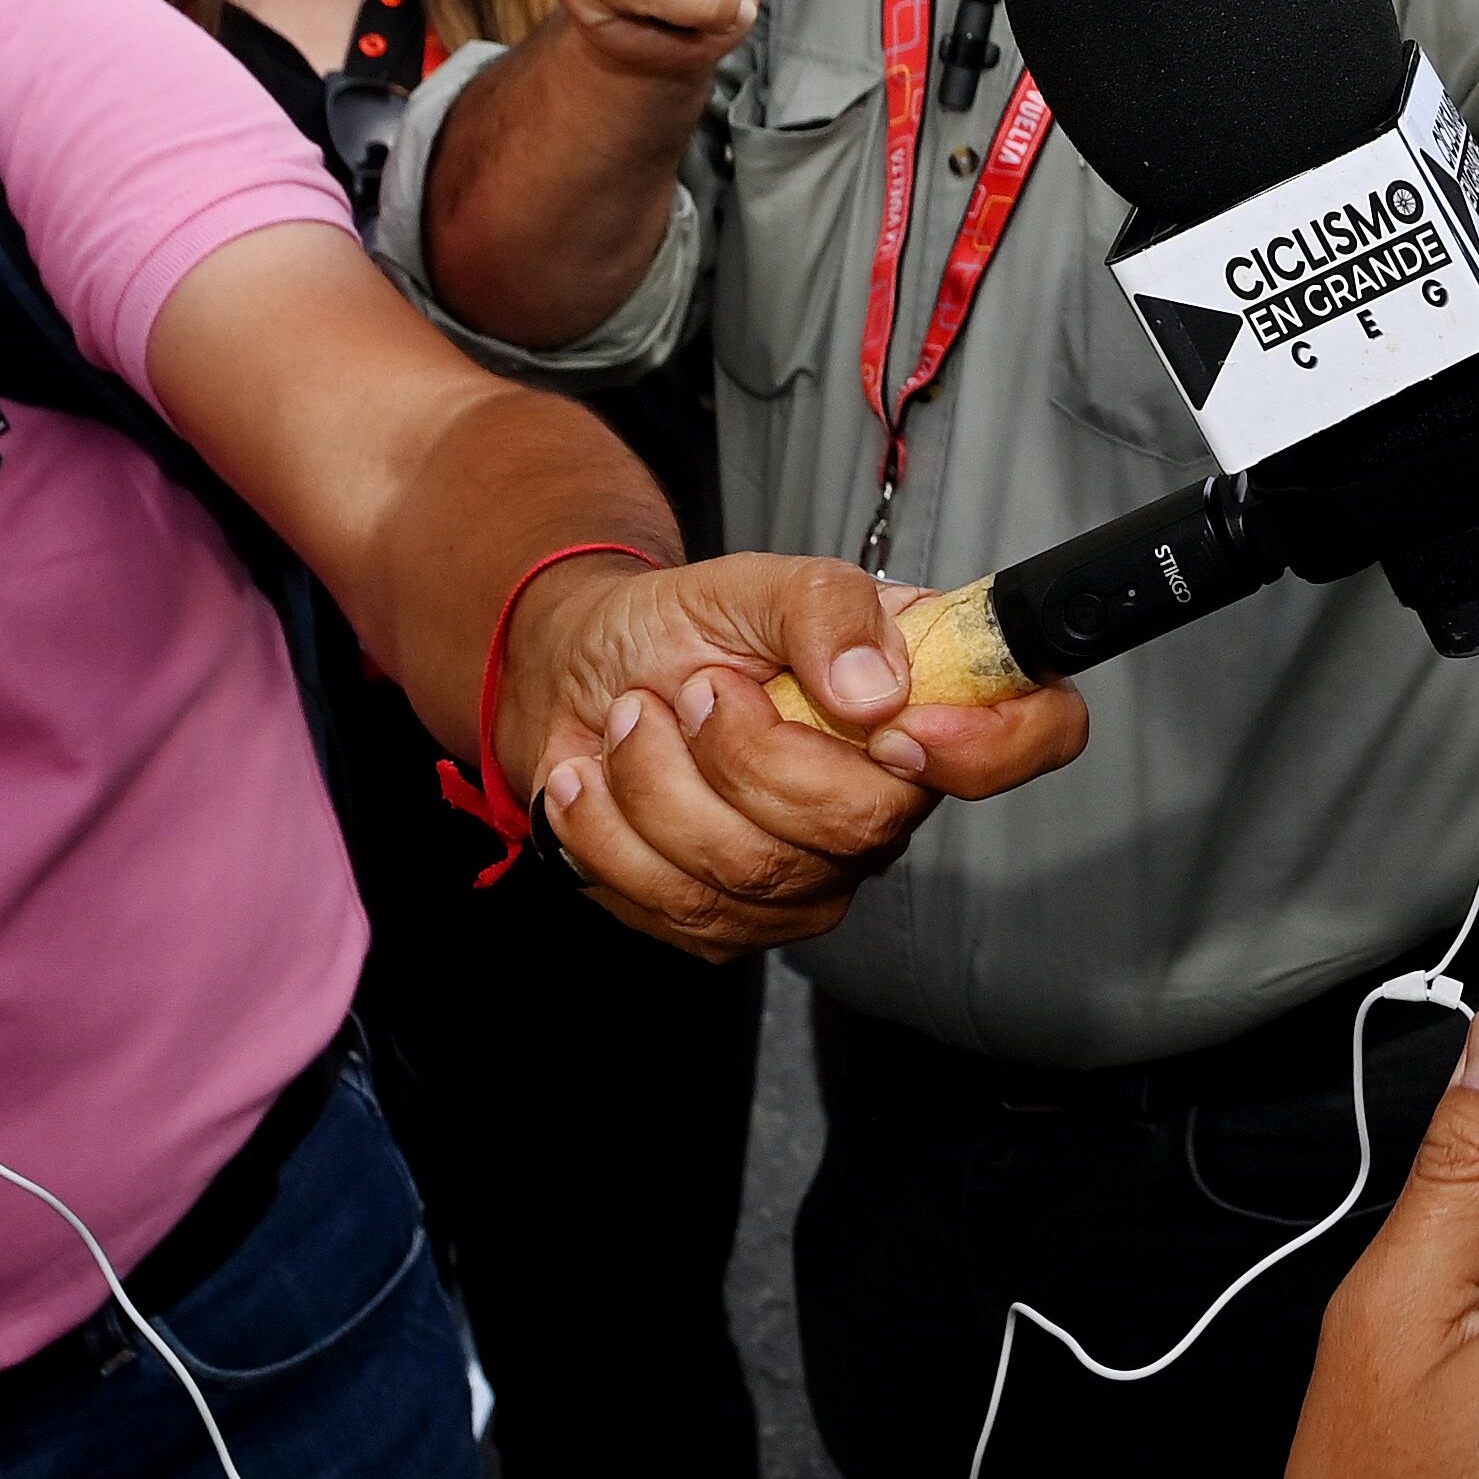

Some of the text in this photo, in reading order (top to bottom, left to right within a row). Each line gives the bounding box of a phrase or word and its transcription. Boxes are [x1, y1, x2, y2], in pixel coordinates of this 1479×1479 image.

[1225, 179, 1425, 301] CICLISMO
[1249, 228, 1447, 345] EN GRANDE
